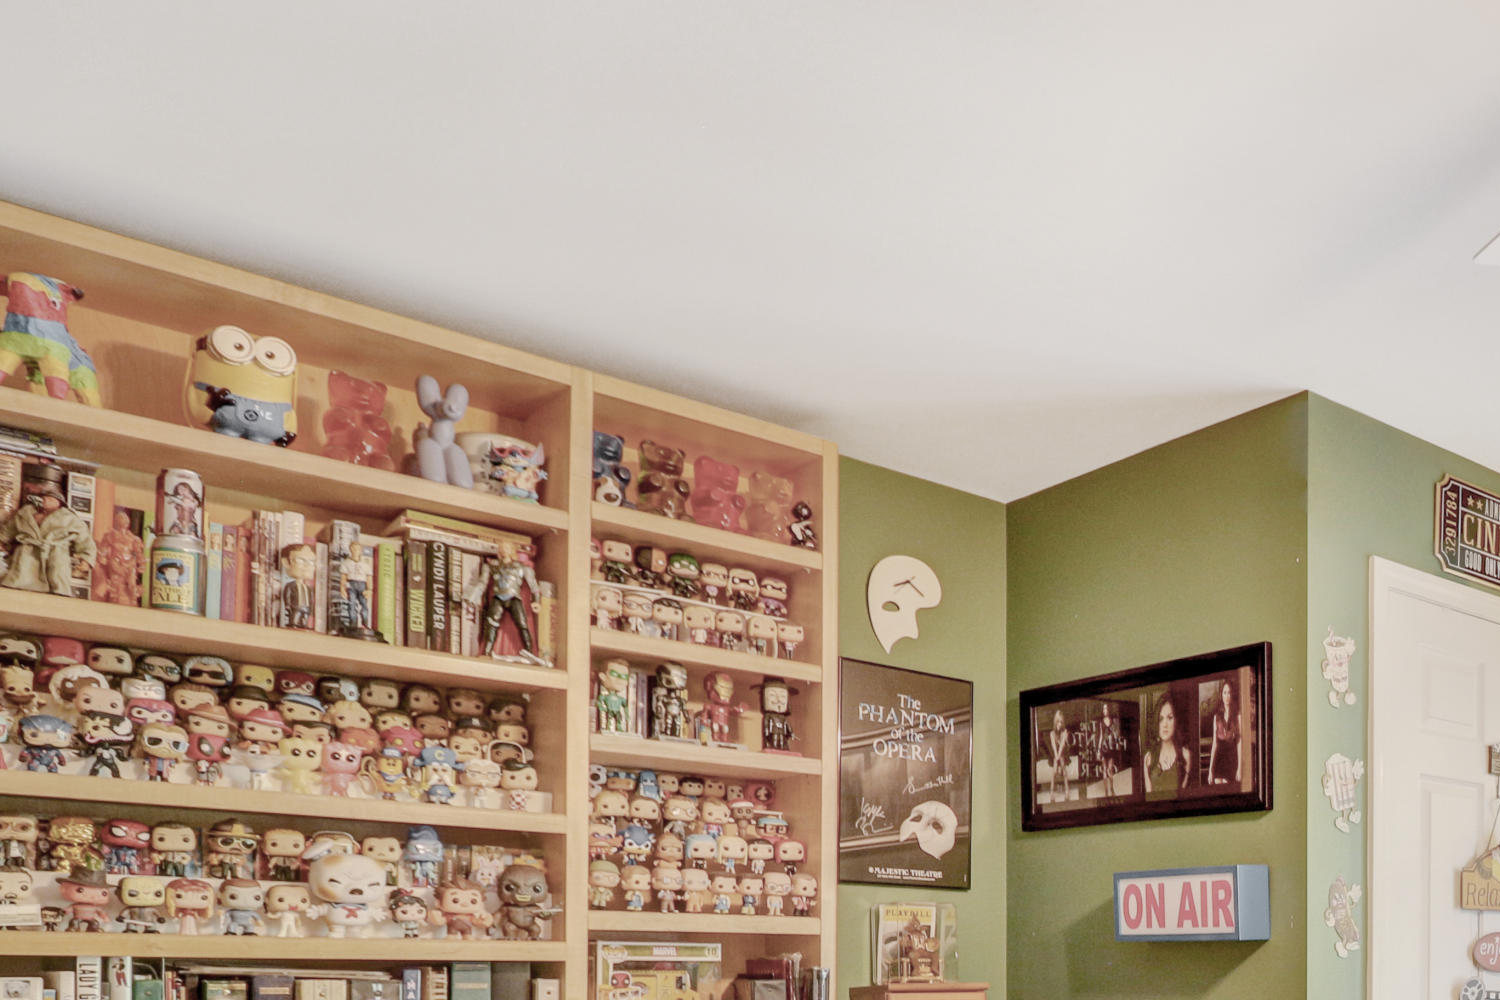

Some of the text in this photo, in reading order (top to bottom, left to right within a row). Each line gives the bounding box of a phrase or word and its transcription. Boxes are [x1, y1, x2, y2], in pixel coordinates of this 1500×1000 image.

[1464, 549, 1482, 573] GOOD
[432, 541, 446, 630] CYNDI LAUPER
[409, 589, 425, 632] WICKED
[896, 693, 922, 711] The
[858, 702, 956, 736] PHANTOM
[890, 727, 924, 744] of the
[872, 739, 937, 764] OPERA
[1123, 879, 1235, 930] ON AIR
[79, 962, 97, 989] LADY
